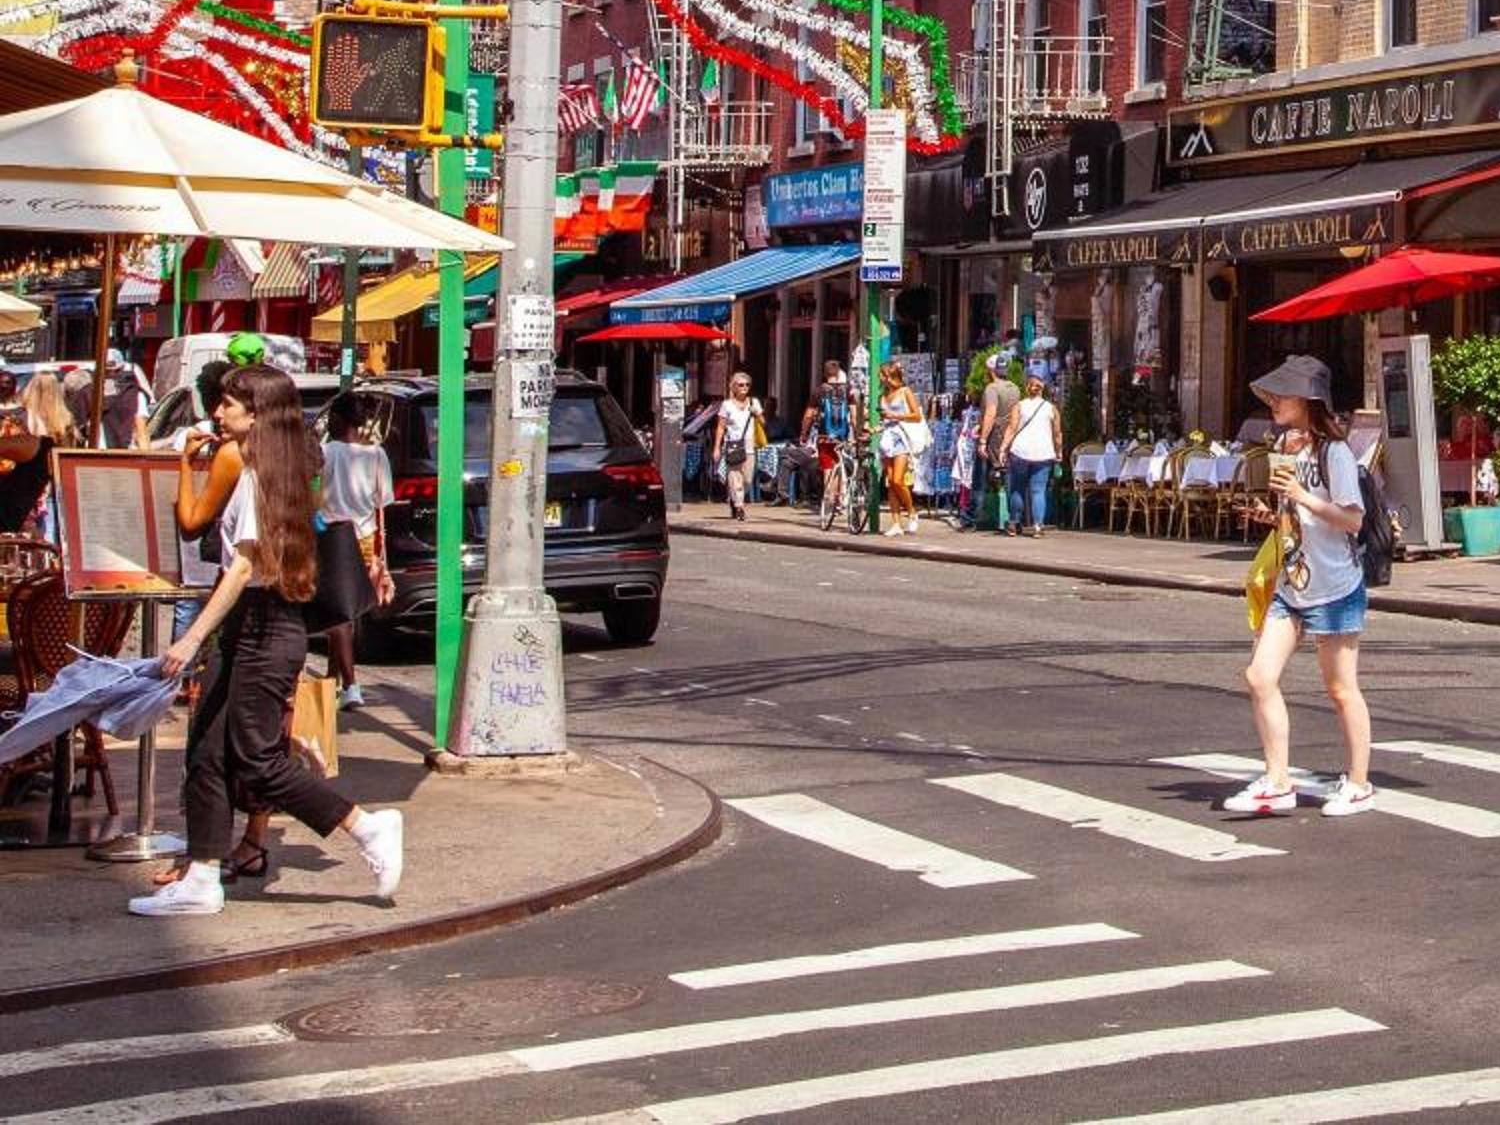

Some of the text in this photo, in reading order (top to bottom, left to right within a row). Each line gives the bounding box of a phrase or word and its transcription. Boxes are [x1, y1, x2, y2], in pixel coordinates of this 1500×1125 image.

[1251, 80, 1456, 145] CAFFE NAPOLI
[1067, 235, 1159, 267] CAFFE NAPOLI
[1241, 213, 1351, 252] CAFFE NAPOLI
